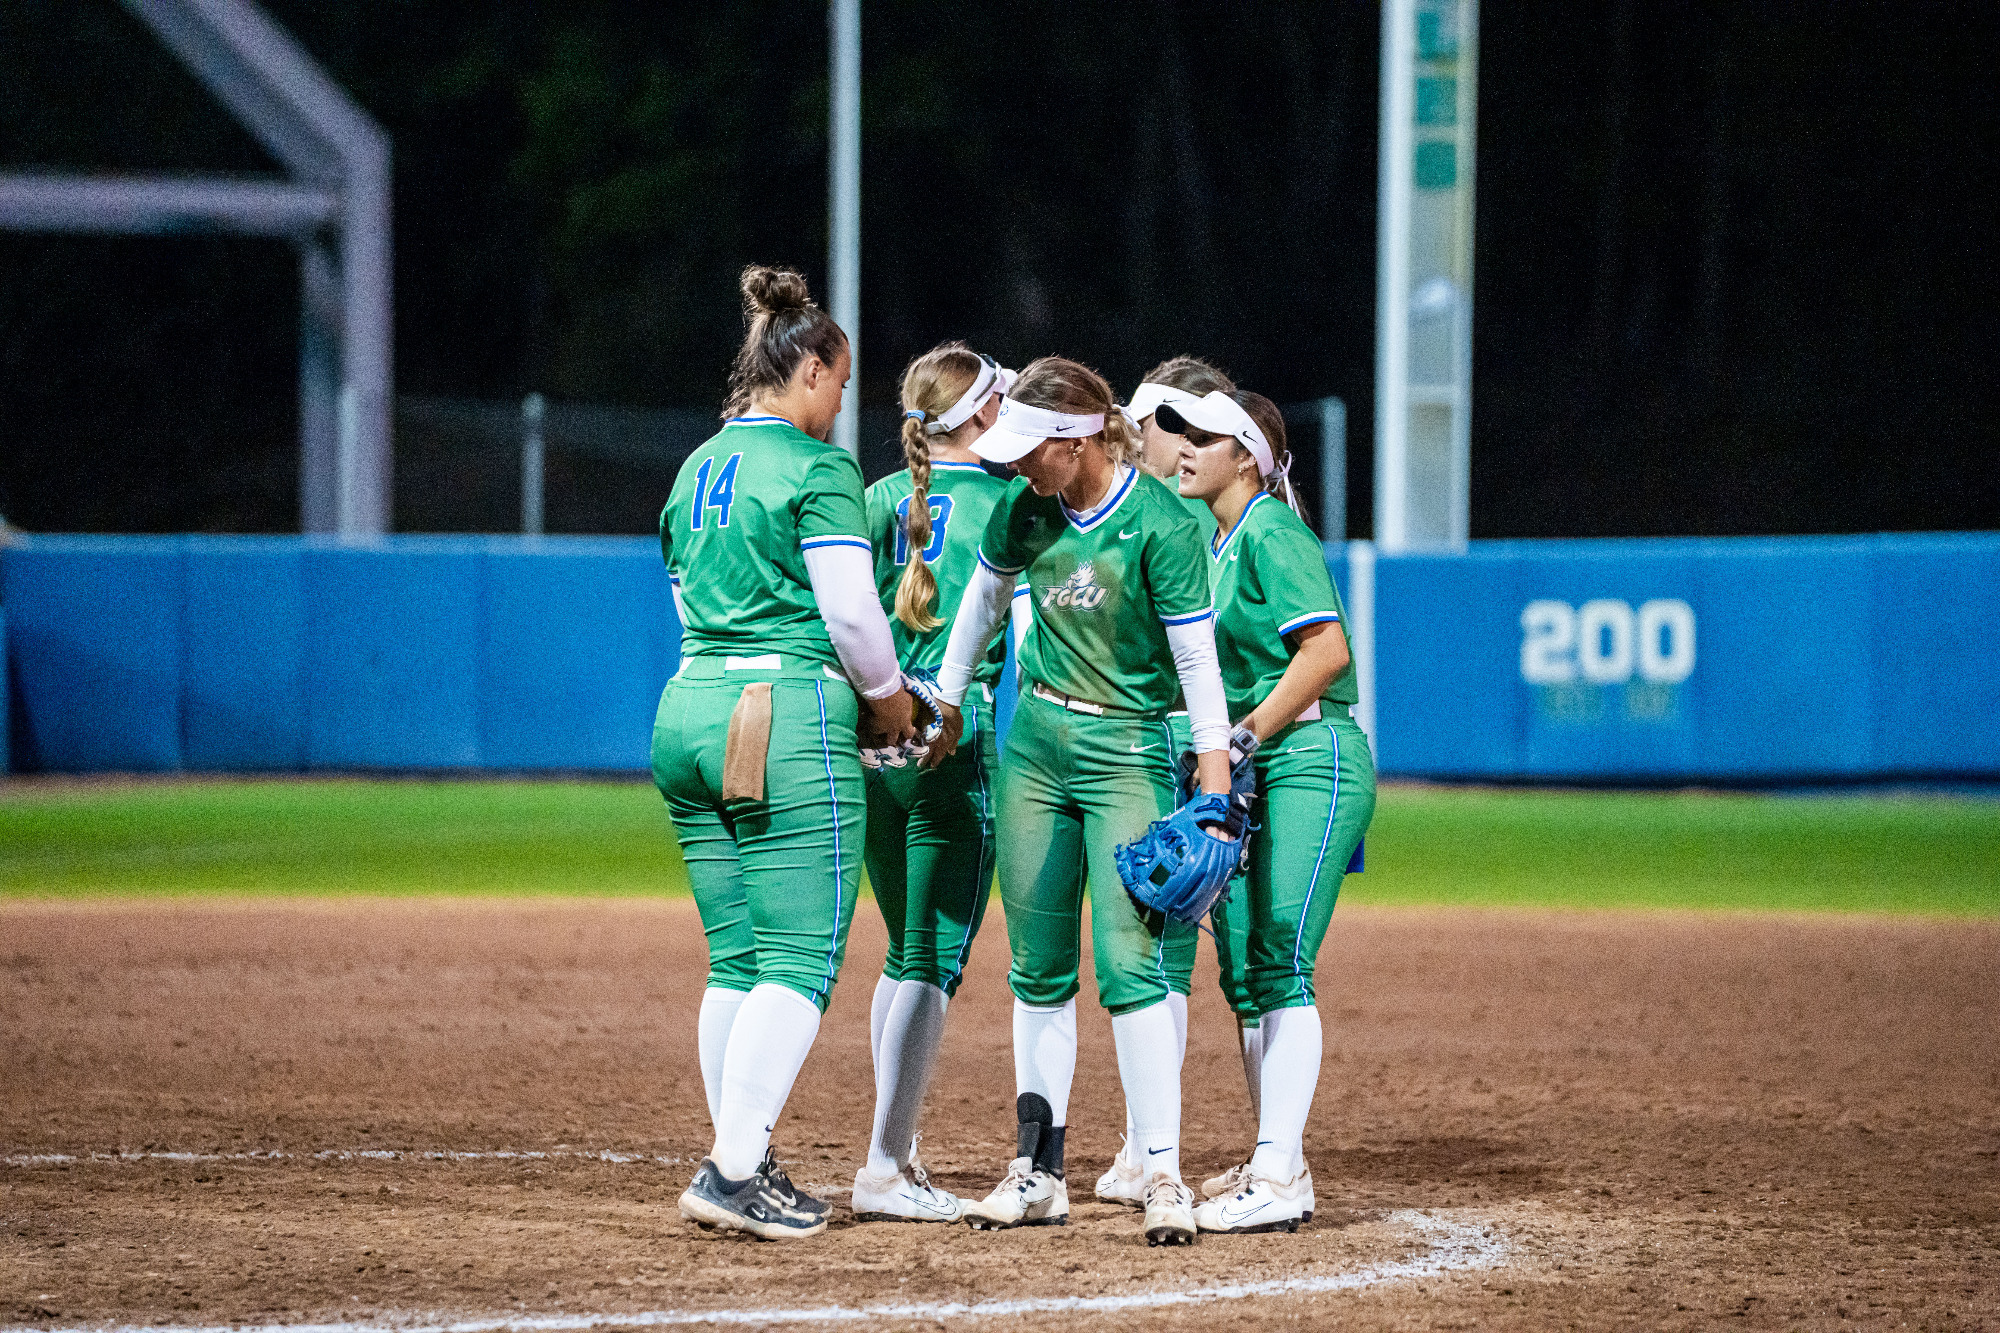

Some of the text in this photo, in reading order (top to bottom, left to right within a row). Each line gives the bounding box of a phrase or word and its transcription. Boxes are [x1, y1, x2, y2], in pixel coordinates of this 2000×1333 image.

[691, 452, 744, 531] 14
[1039, 585, 1110, 611] FGCU
[1520, 598, 1697, 684] 200
